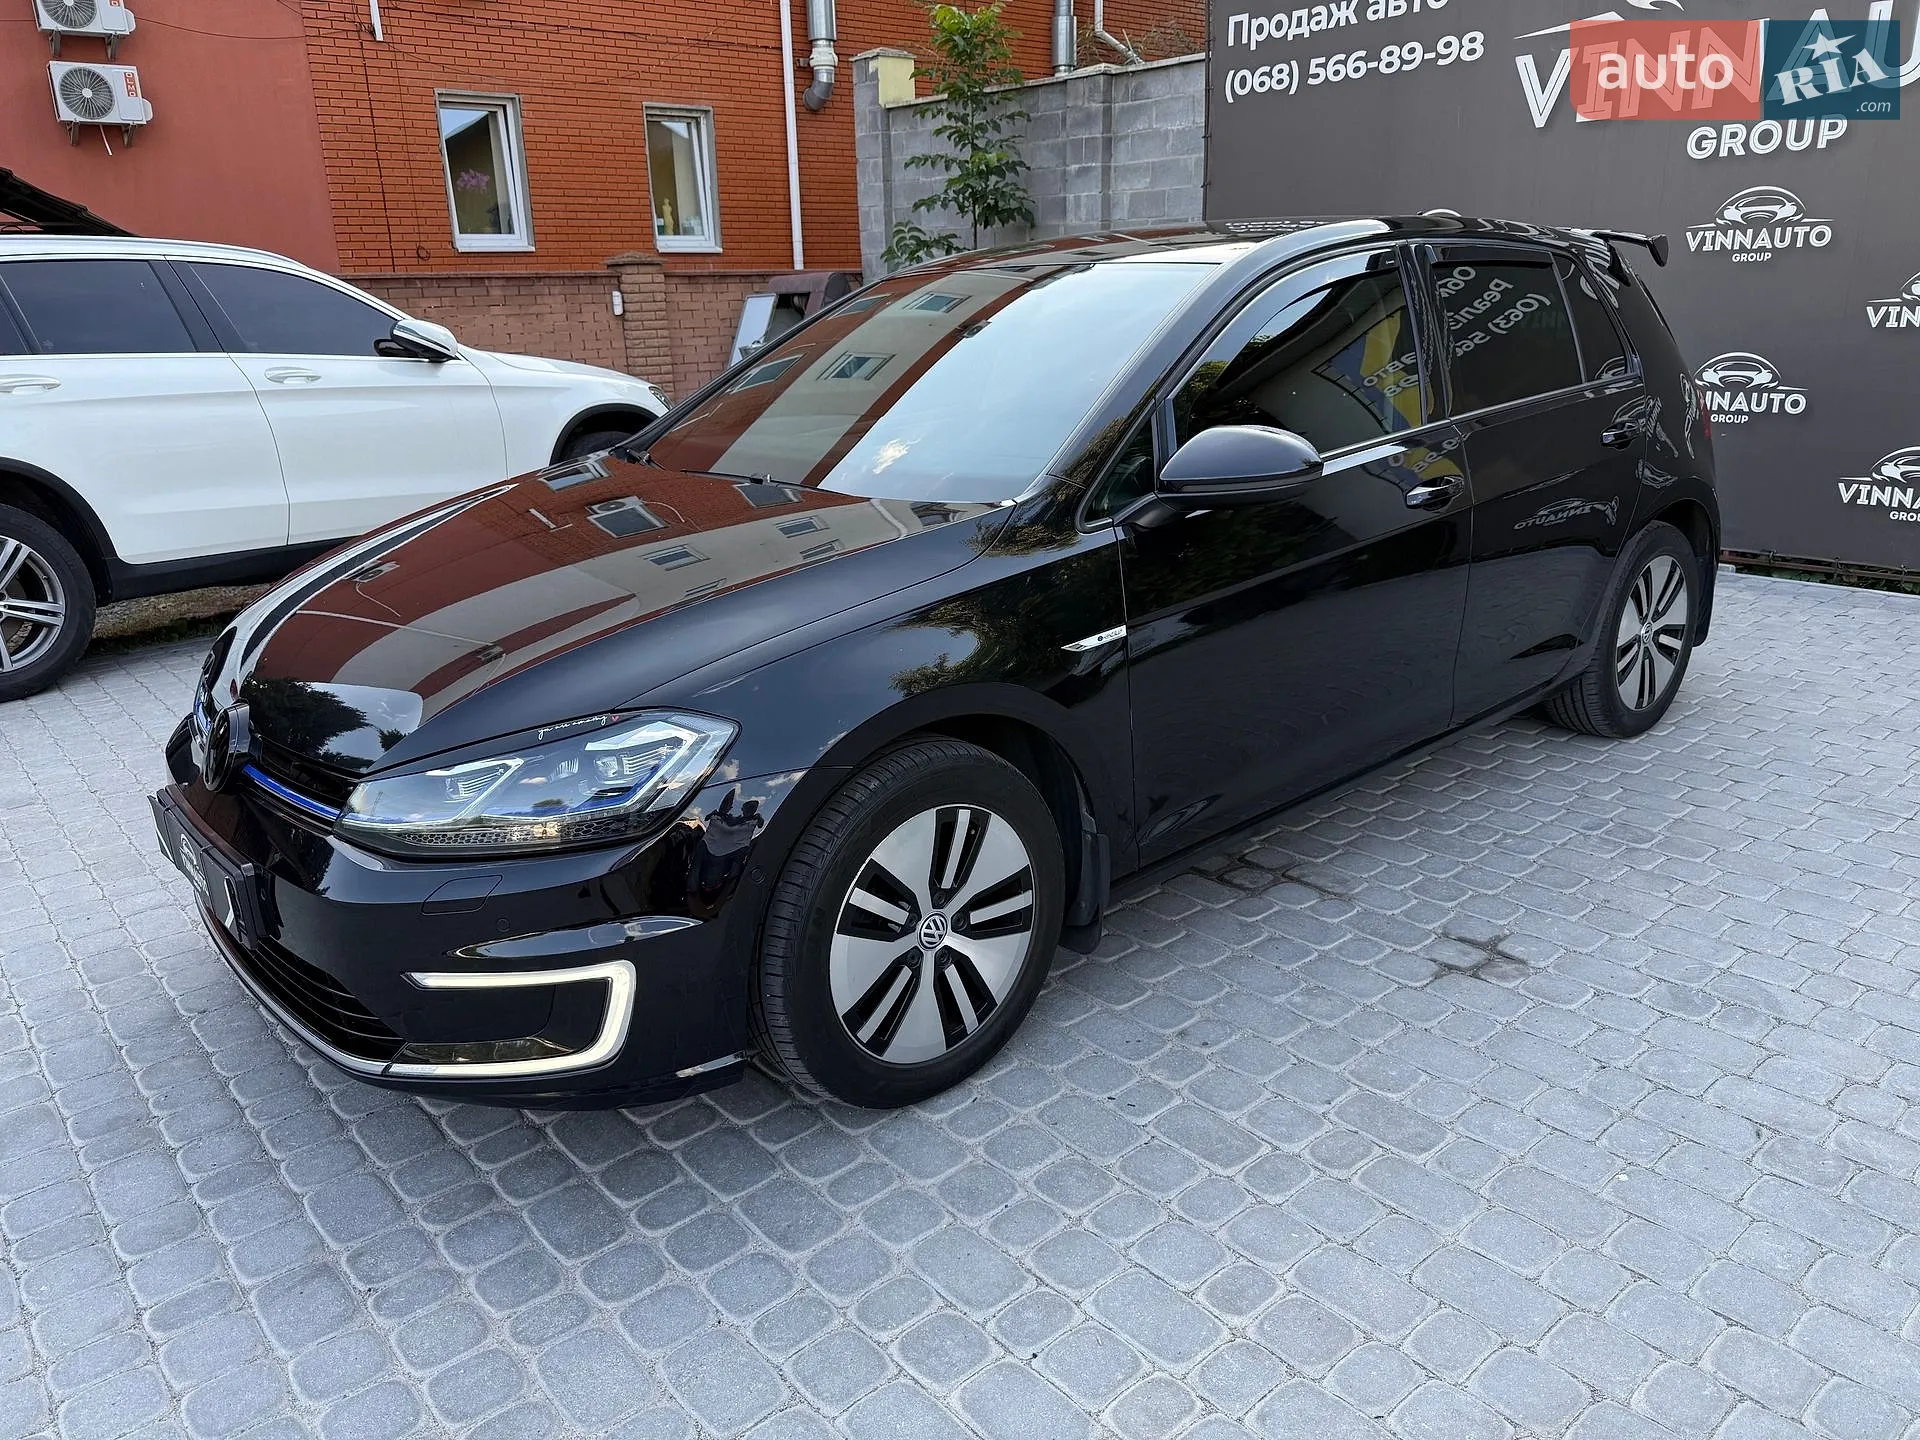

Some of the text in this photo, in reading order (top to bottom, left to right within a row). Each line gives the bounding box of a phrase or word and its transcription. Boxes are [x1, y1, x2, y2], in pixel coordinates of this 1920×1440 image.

[1227, 0, 1359, 51] Продаж
[1225, 30, 1486, 104] (068) 566-89-98
[1686, 114, 1848, 160] GROUP
[1685, 224, 1833, 252] VINNAUTO
[1731, 251, 1773, 263] GROUP
[1710, 413, 1749, 424] GROUP
[1889, 510, 1920, 522] GRO
